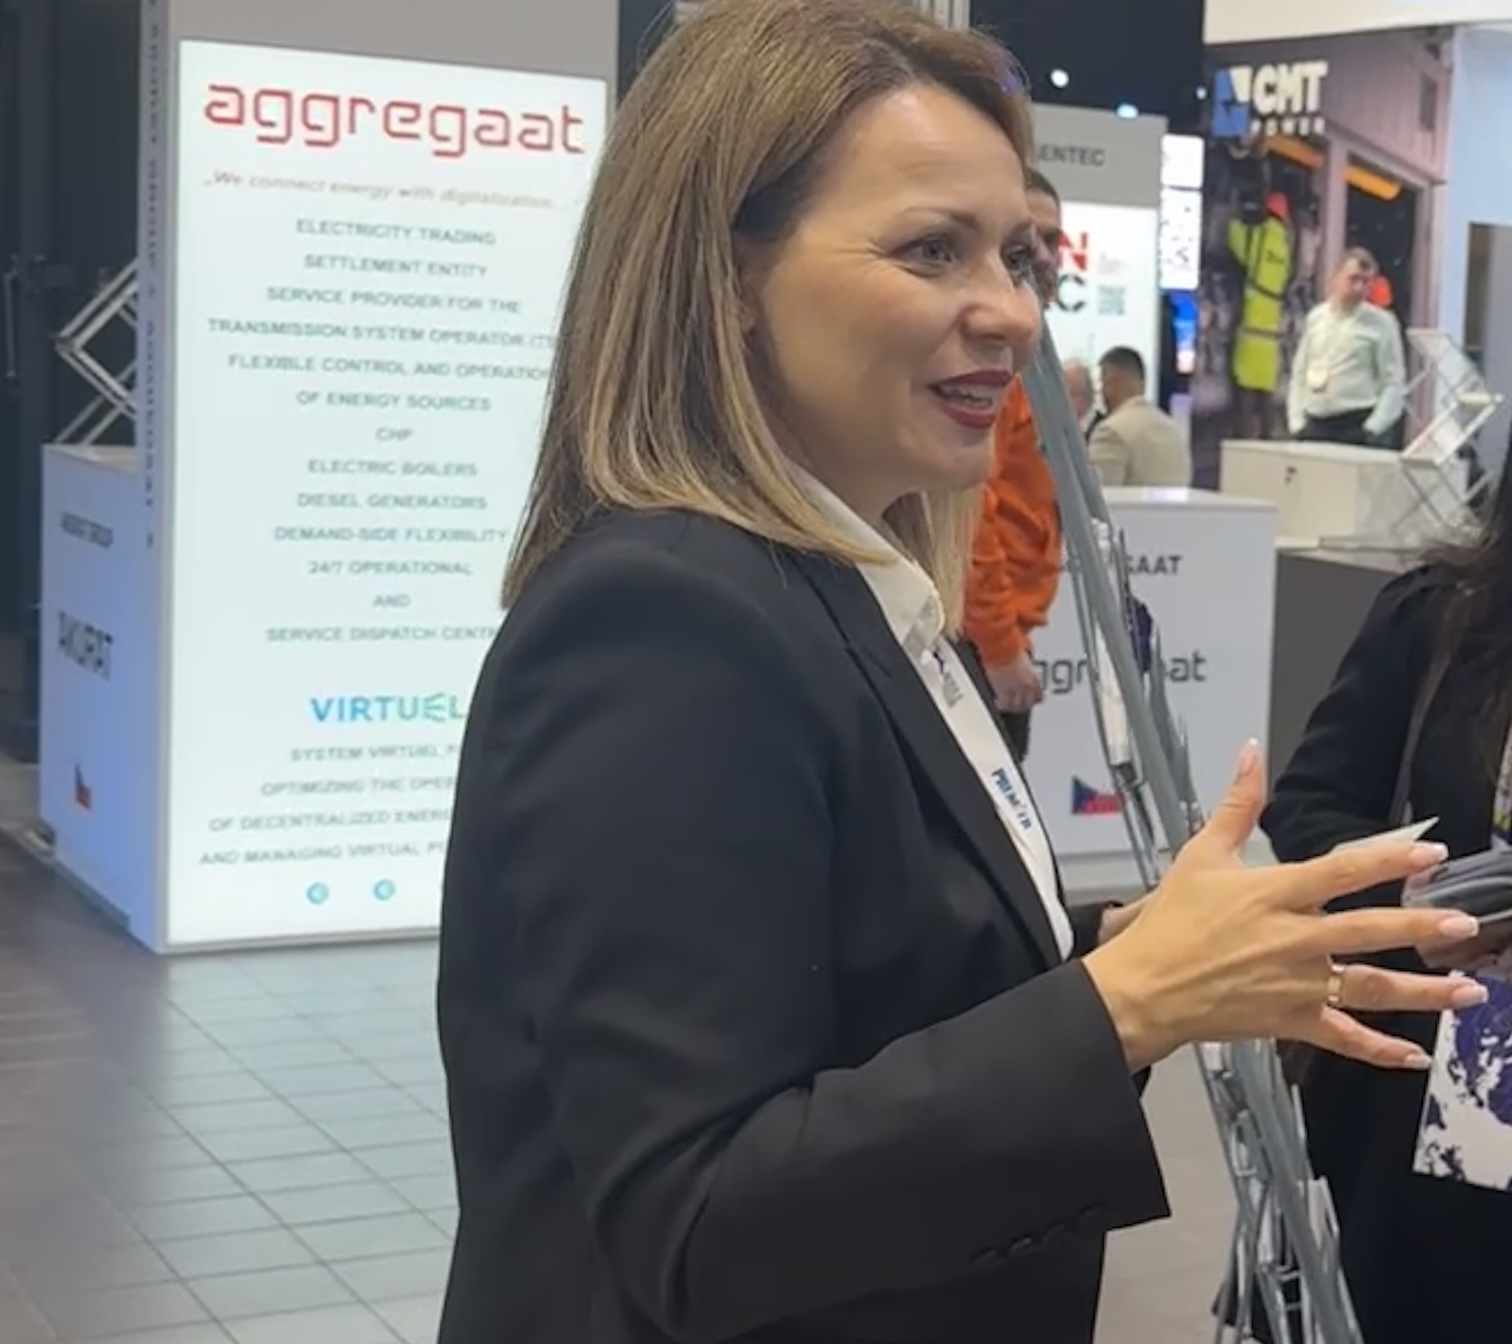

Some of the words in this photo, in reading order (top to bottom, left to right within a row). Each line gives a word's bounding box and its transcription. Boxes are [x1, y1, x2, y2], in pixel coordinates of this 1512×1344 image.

[1253, 60, 1328, 115] CMT
[204, 83, 585, 159] aggregaat
[249, 174, 326, 192] connect
[330, 181, 392, 201] energy
[296, 218, 413, 240] ELECTRICITY
[420, 227, 496, 246] TRADING
[304, 253, 421, 274] SETTLEMENT
[427, 261, 488, 278] ENTITY
[266, 285, 344, 305] SERVICE
[349, 289, 441, 310] PROVIDER
[446, 295, 483, 312] FOR
[489, 297, 523, 314] THE
[207, 317, 346, 339] TRANSMISSION
[352, 324, 425, 342] SYSTEM
[429, 328, 524, 348] OPERATOR
[228, 353, 315, 372] FLEXIBLE
[321, 357, 408, 375] CONTROL
[413, 361, 451, 376] AND
[296, 390, 321, 407] OF
[326, 393, 401, 410] ENERGY
[406, 394, 491, 412] SOURCES
[375, 427, 413, 442] CHP
[308, 458, 396, 476] ELECTRIC
[401, 460, 478, 478] BOILERS
[296, 492, 360, 510] DIESEL
[366, 492, 487, 510] GENERATORS
[273, 525, 398, 542] DEMAND-SIDE
[348, 560, 474, 576] OPERATIONAL
[372, 594, 411, 609] AND
[266, 627, 343, 642] SERVICE
[349, 626, 436, 642] DISPATCH
[310, 691, 465, 724] VIRTUEL
[291, 746, 363, 763] SYSTEM
[260, 778, 365, 796] OPTIMIZING
[370, 777, 405, 793] THE
[208, 816, 233, 832] OF
[240, 809, 392, 831] DECENTRALIZED
[243, 844, 342, 864] MANAGING
[347, 841, 420, 858] VIRTUAL
